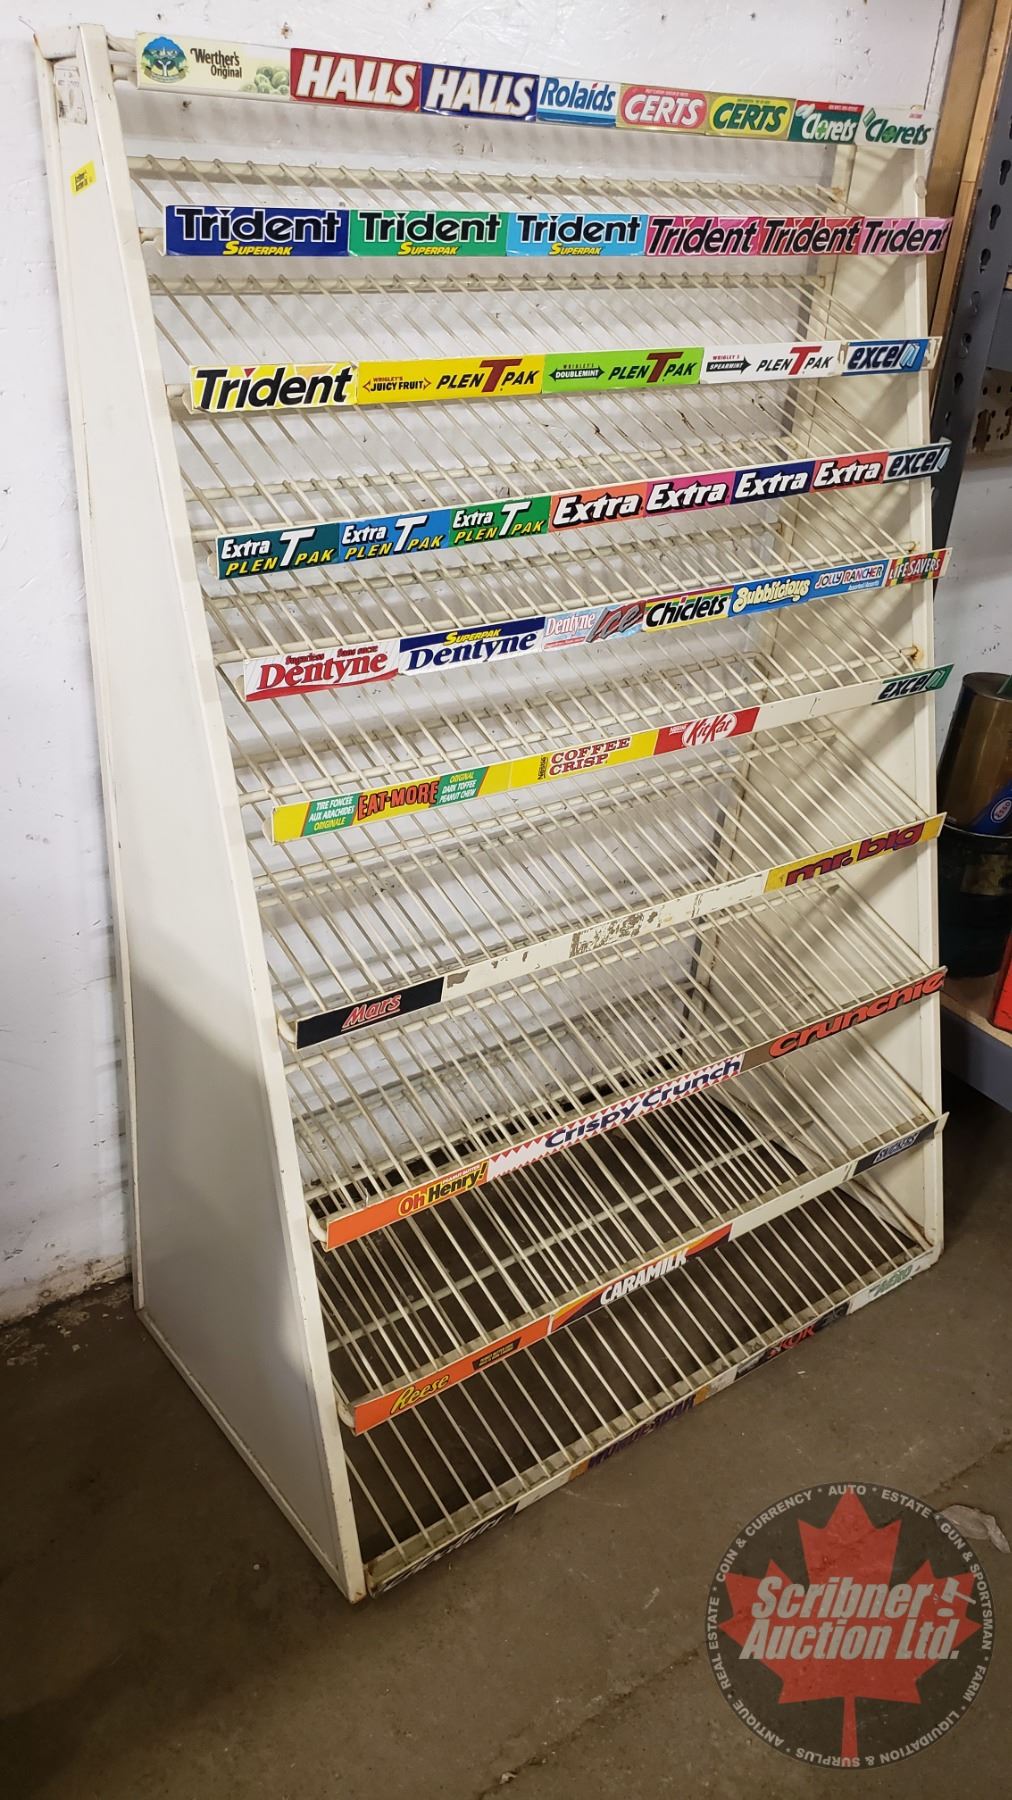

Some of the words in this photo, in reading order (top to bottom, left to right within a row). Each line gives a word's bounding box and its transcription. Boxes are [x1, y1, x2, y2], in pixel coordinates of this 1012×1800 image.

[190, 48, 240, 67] Werther's
[210, 64, 242, 79] Original
[295, 53, 417, 106] HALLS
[425, 68, 535, 118] HALLS
[540, 77, 616, 112] Rolaids
[625, 94, 704, 127] CERTS
[711, 101, 788, 132] CERTS
[801, 112, 858, 141] Clorets
[865, 117, 931, 145] Clorets
[175, 207, 341, 243] Trident
[358, 210, 500, 244] Trident
[517, 213, 641, 245] Trident
[649, 217, 759, 255] Trident
[760, 217, 860, 254] Trident
[222, 240, 293, 256] SUPERPAK
[398, 242, 458, 256] SUPERPAK
[847, 342, 907, 370] excel
[195, 365, 354, 411] Trident
[370, 382, 397, 391] JUICY
[398, 380, 424, 390] FRUIT
[555, 368, 599, 380] DOUBLEMINT
[813, 460, 883, 488] Extra
[886, 449, 941, 477] excel
[645, 481, 728, 512] Extra
[734, 471, 809, 499] Extra
[452, 508, 494, 529] Extra
[552, 493, 642, 528] Extra
[221, 538, 270, 560] Extra
[341, 524, 387, 545] Extra
[815, 571, 843, 589] JOLLY
[842, 564, 884, 584] RANCHER
[889, 562, 909, 579] LIFE
[908, 558, 941, 577] SAVERS
[732, 579, 810, 613] Bubblicious
[545, 613, 596, 637] Dentyne
[586, 608, 643, 643] Ice
[646, 596, 730, 629] Chiclets
[442, 628, 502, 646] SUPERPAK
[406, 632, 538, 672] Dentyne
[257, 652, 388, 690] Dentyne
[877, 670, 935, 702] excel
[549, 753, 608, 777] CRISP
[550, 737, 631, 765] COFFEE
[441, 784, 457, 794] DARK
[457, 780, 476, 791] TOFFEE
[449, 771, 474, 784] ORIGINAL
[316, 800, 329, 811] TIRE
[439, 792, 461, 803] PEANUT
[308, 812, 323, 822] AUX
[323, 806, 355, 819] ARACHIDES
[314, 817, 346, 831] ORIGINALE
[785, 849, 854, 887] mr.
[857, 821, 925, 861] big
[342, 994, 402, 1029] Mars
[769, 970, 946, 1058] crunchie
[544, 1101, 643, 1149] Crispy
[642, 1059, 742, 1109] Crunch
[398, 1193, 425, 1216] Oh
[427, 1163, 488, 1203] Henry!
[600, 1248, 688, 1307] CARAMILK
[390, 1375, 450, 1415] Reese
